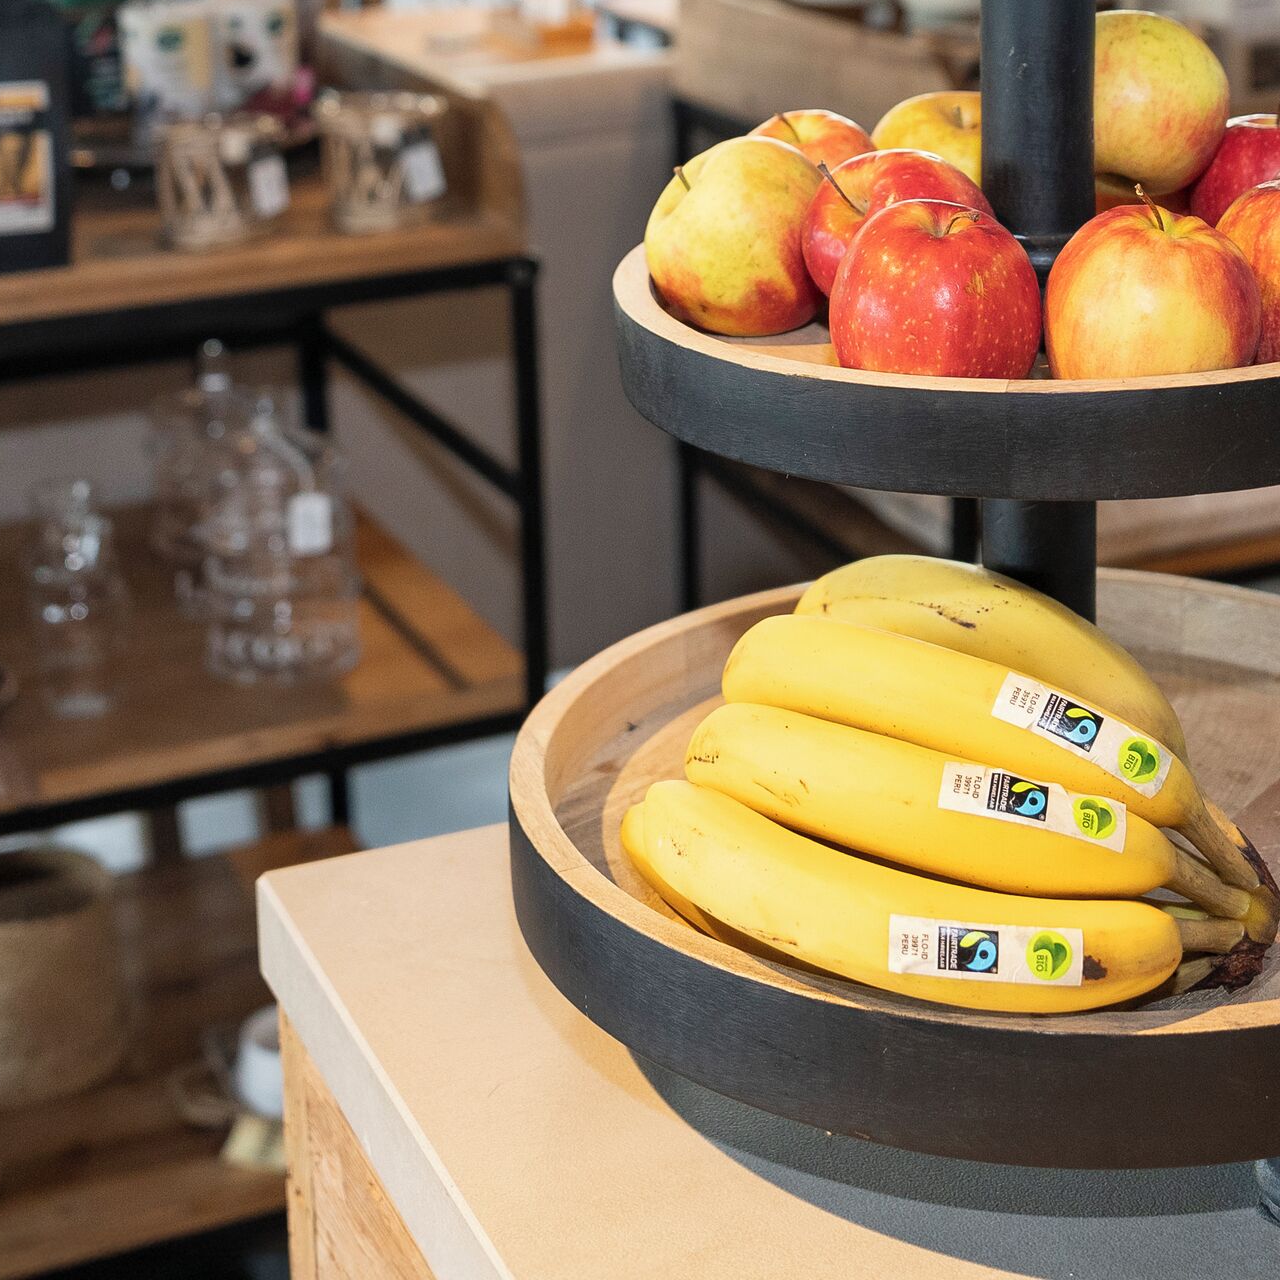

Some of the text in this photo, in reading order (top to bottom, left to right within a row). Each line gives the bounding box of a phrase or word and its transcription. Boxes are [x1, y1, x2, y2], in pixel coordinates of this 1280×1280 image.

[1010, 687, 1021, 705] PERU
[1124, 754, 1136, 770] BIO
[953, 774, 962, 794] PERU
[972, 775, 982, 799] FLO-ID
[1000, 775, 1011, 812] FAIRTRADE
[1082, 812, 1091, 829] BIO
[901, 933, 909, 955] PERU
[921, 933, 929, 960] FLO-ID
[950, 928, 959, 969] FAIRTRADE
[1036, 954, 1045, 972] BIO
